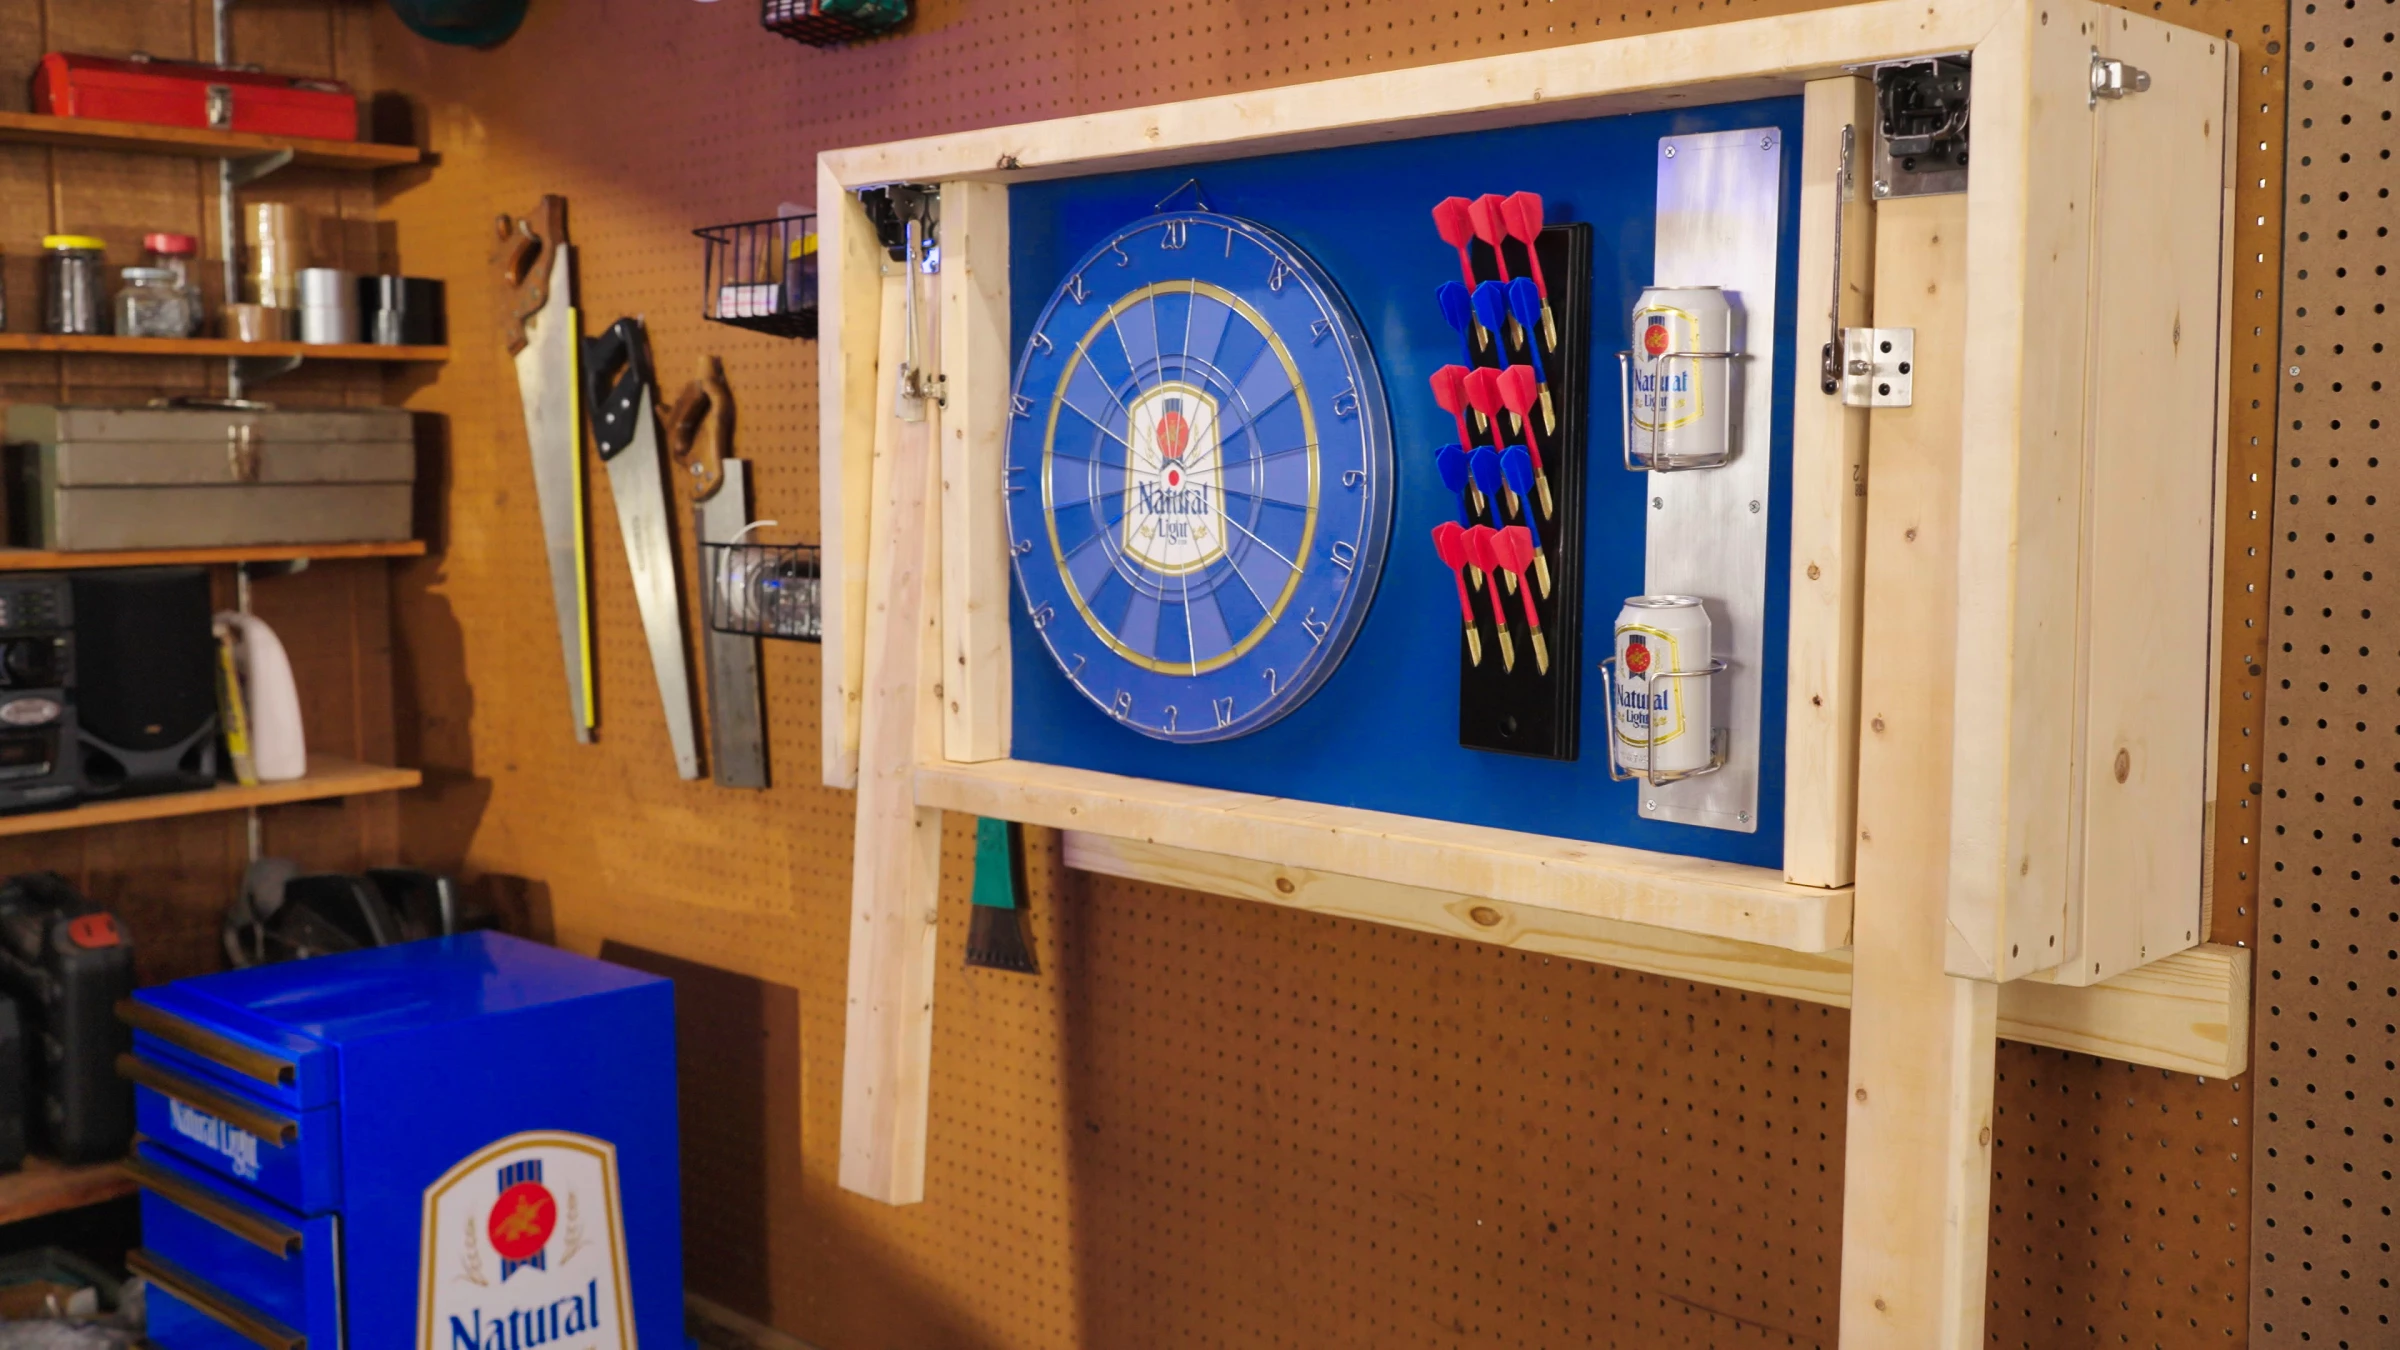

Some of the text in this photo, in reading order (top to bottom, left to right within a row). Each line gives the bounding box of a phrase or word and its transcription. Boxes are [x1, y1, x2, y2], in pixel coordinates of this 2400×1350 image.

[1160, 219, 1187, 250] 20
[1063, 273, 1091, 305] 12
[1266, 255, 1291, 292] 18
[1310, 319, 1331, 344] 4
[1331, 375, 1360, 416] 13
[1138, 480, 1209, 516] Natural
[1157, 517, 1188, 546] Light
[1330, 540, 1358, 574] 10
[1301, 606, 1329, 646] 15
[1262, 667, 1283, 696] 2
[1616, 683, 1669, 711] Natual
[1111, 687, 1132, 720] 19
[1162, 705, 1178, 735] 3
[1212, 696, 1234, 729] 17
[448, 1277, 600, 1350] Natural
